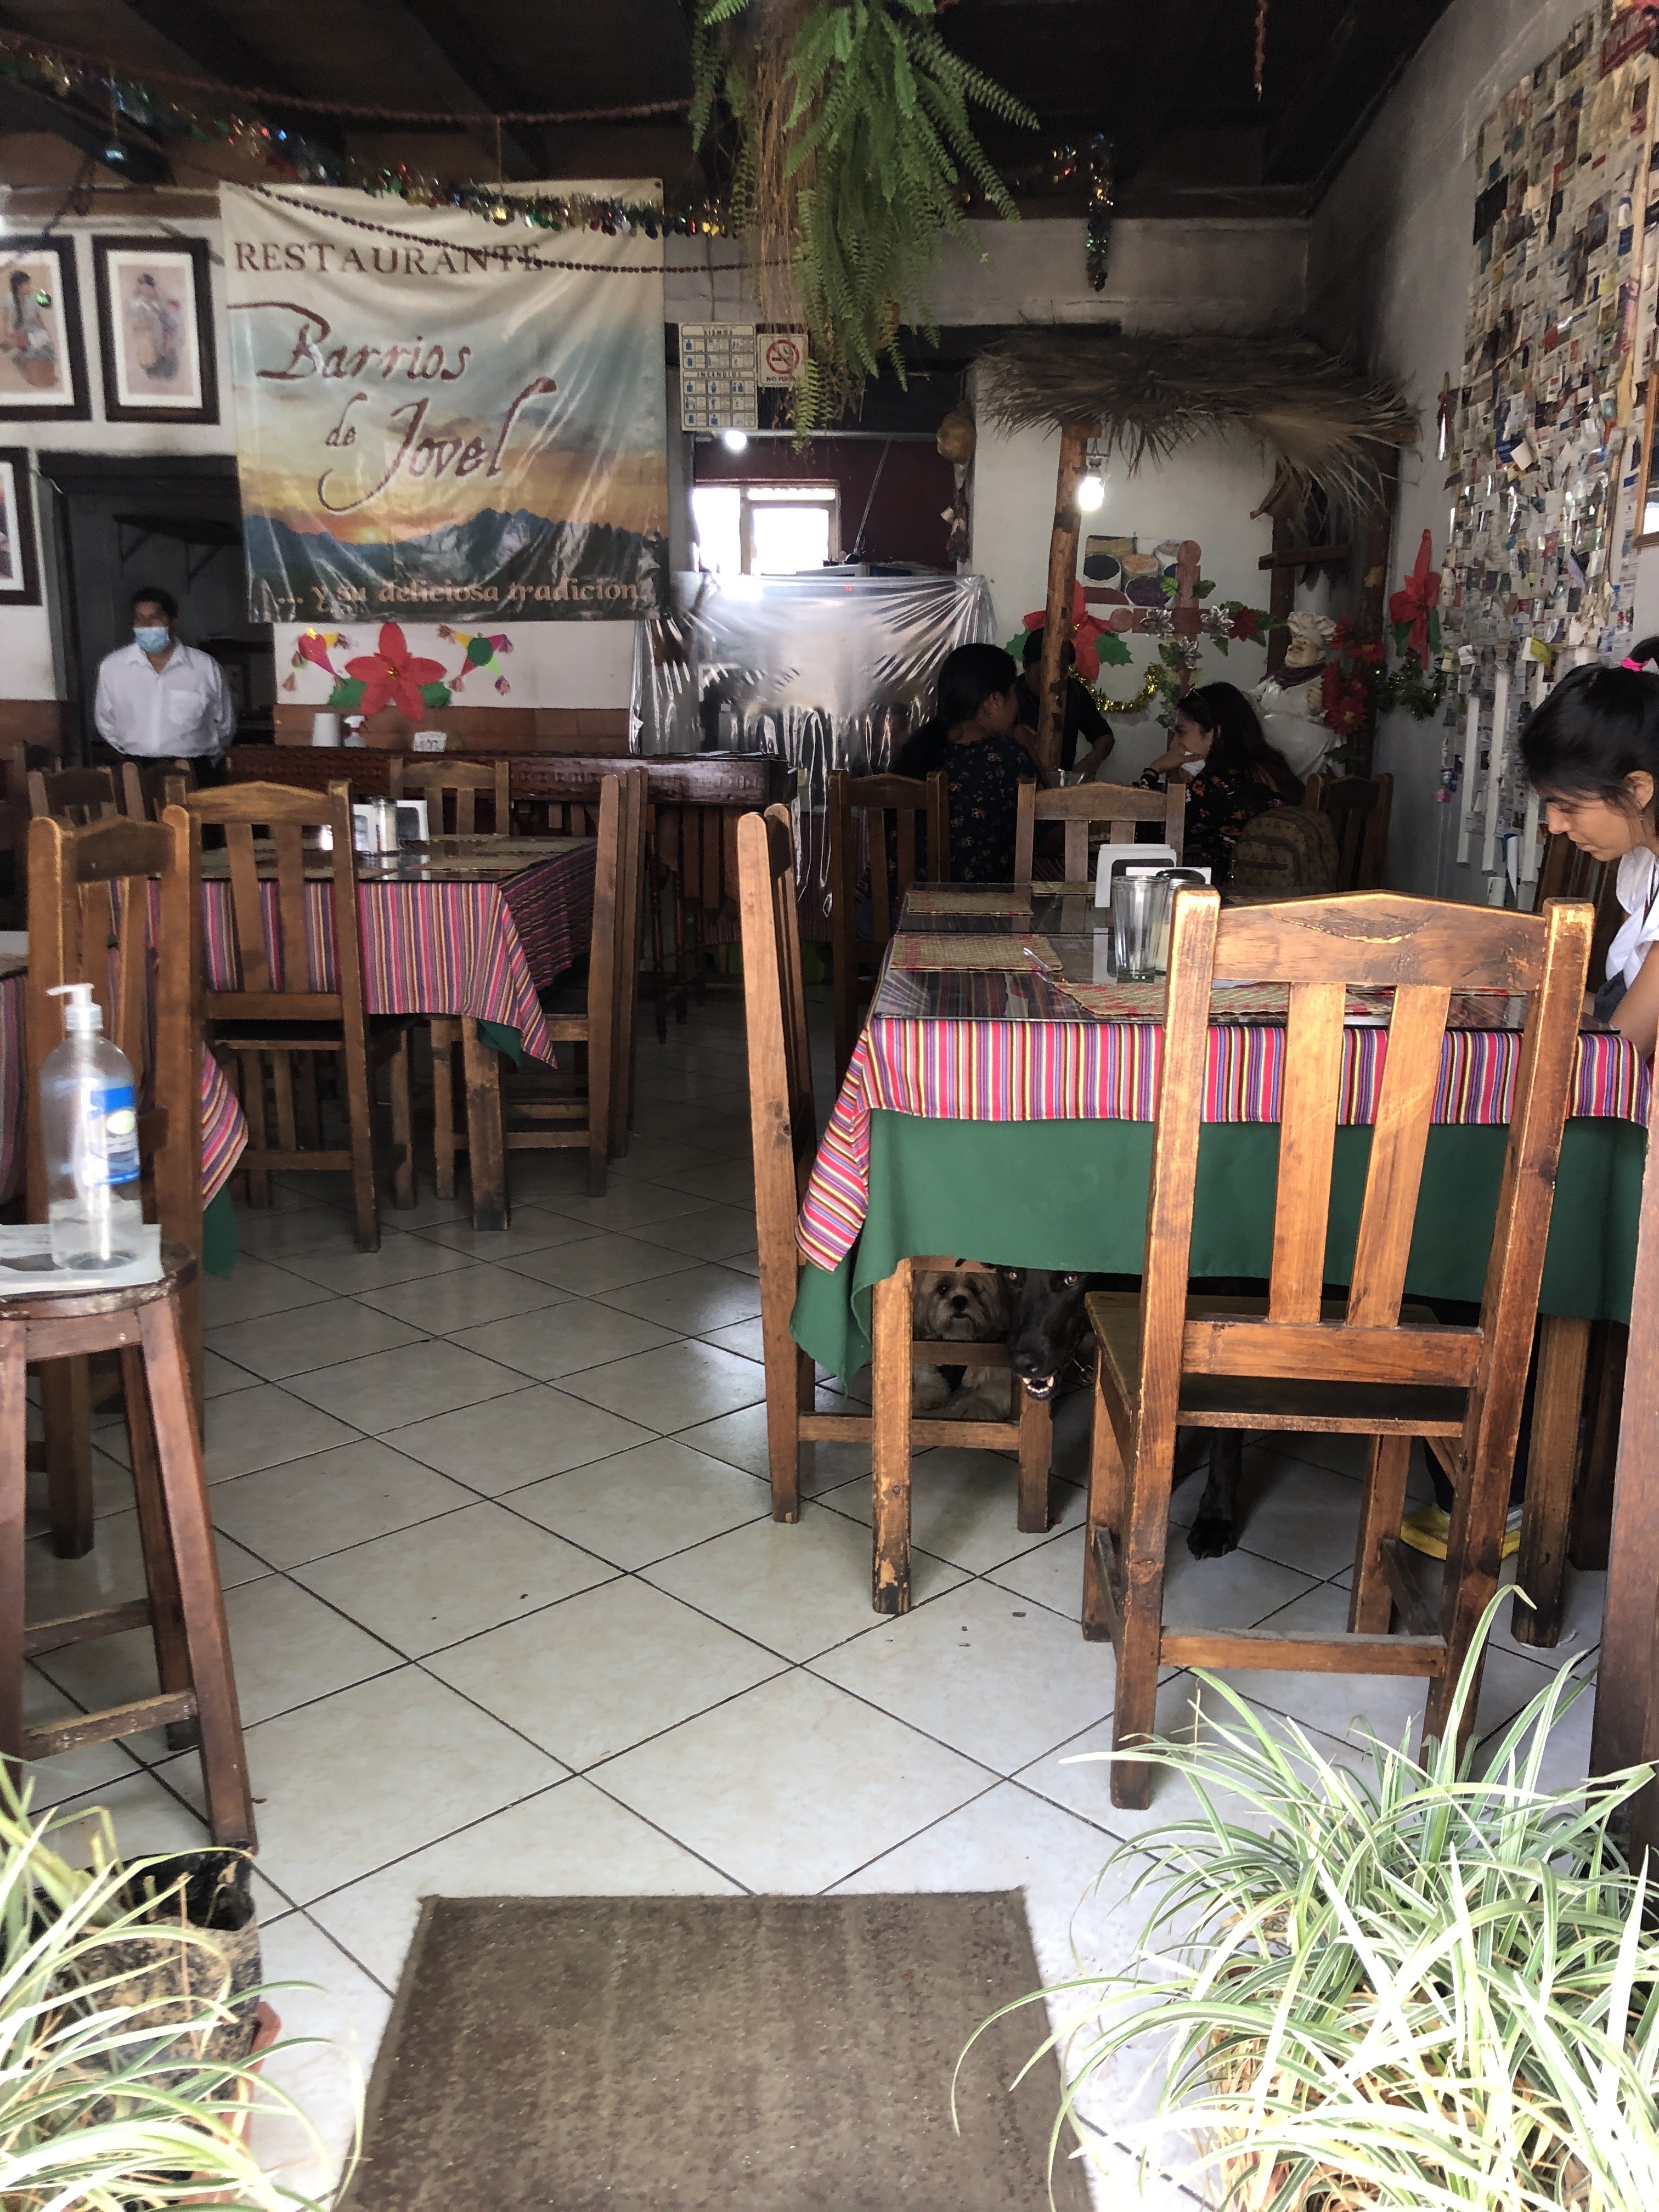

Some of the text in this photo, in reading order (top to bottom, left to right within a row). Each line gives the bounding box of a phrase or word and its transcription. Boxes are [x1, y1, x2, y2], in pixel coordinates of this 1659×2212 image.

[235, 241, 540, 274] RESTAURANTE
[226, 301, 471, 381] Barrios
[318, 376, 557, 512] de Jovel
[311, 585, 330, 613] y
[336, 586, 366, 602] su
[377, 579, 499, 602] deliciosa
